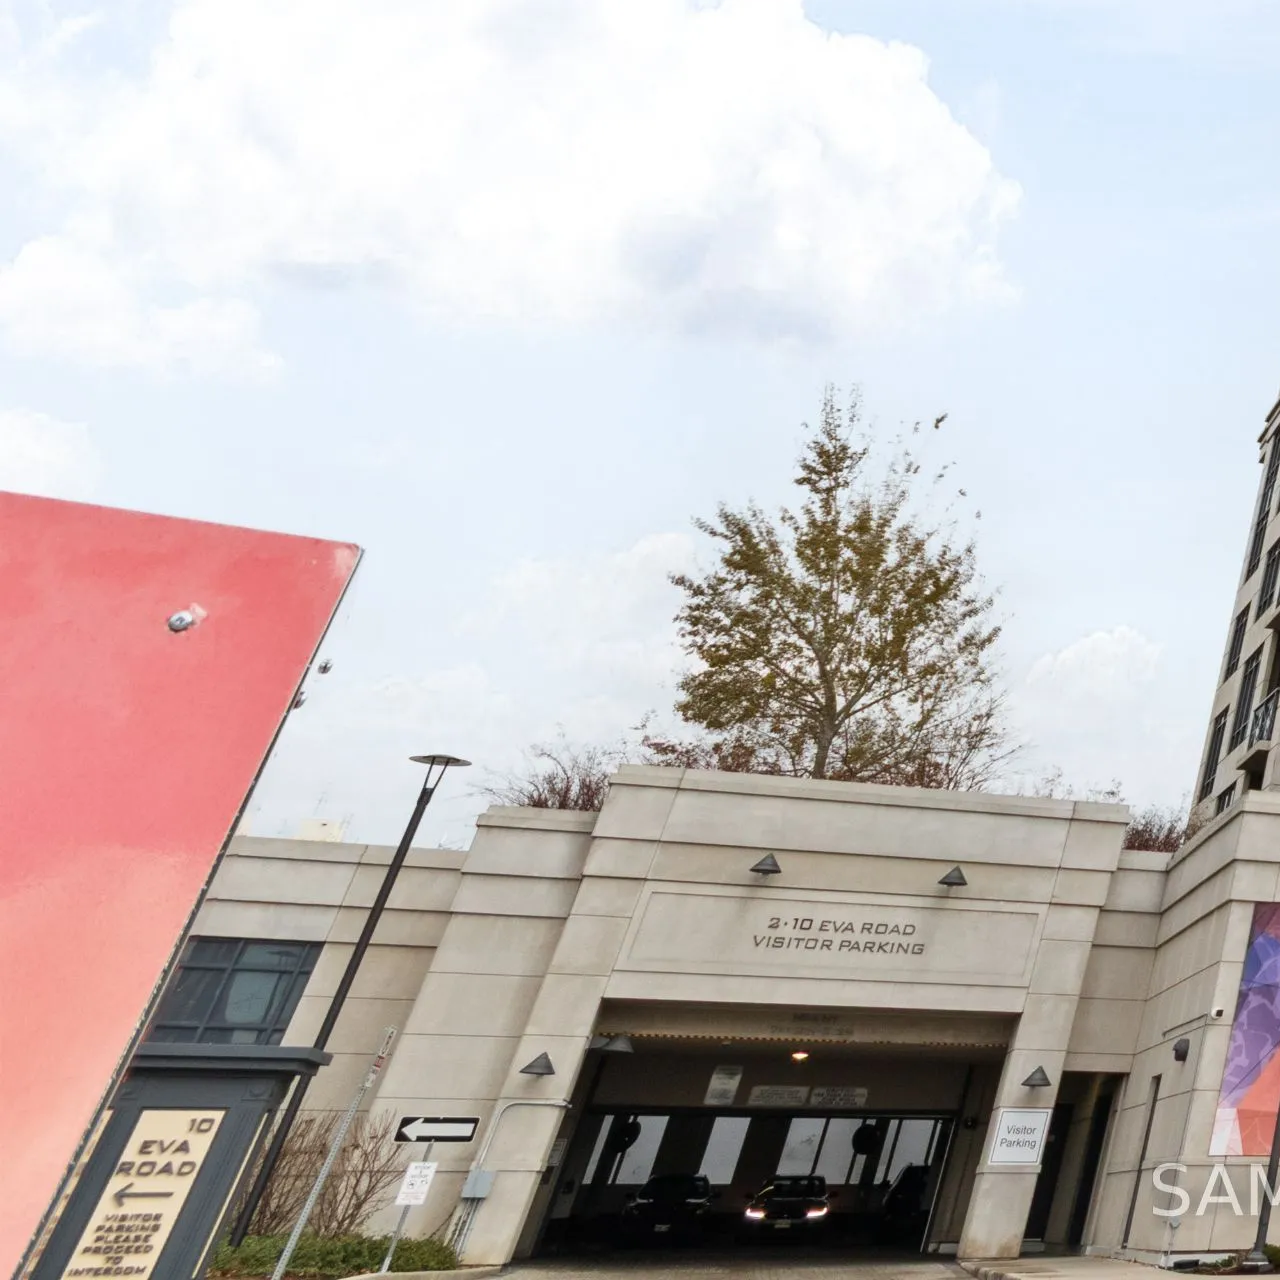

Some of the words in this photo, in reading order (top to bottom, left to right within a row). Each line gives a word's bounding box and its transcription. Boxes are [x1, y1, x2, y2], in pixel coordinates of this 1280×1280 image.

[818, 920, 855, 934] EVA
[860, 922, 916, 936] ROAD
[753, 935, 833, 951] VISITOR
[838, 940, 925, 955] PARKING
[187, 1118, 215, 1134] 10
[1007, 1125, 1037, 1135] Visitor
[138, 1140, 190, 1155] EVA
[1000, 1138, 1037, 1150] Parking
[115, 1161, 196, 1177] ROAD
[104, 1213, 163, 1223] VISITOR
[95, 1223, 162, 1233] PARKING
[94, 1234, 153, 1244] PLEASE
[81, 1244, 154, 1255] PROCEED
[104, 1255, 124, 1265] TO
[68, 1266, 148, 1277] INTERCOM
